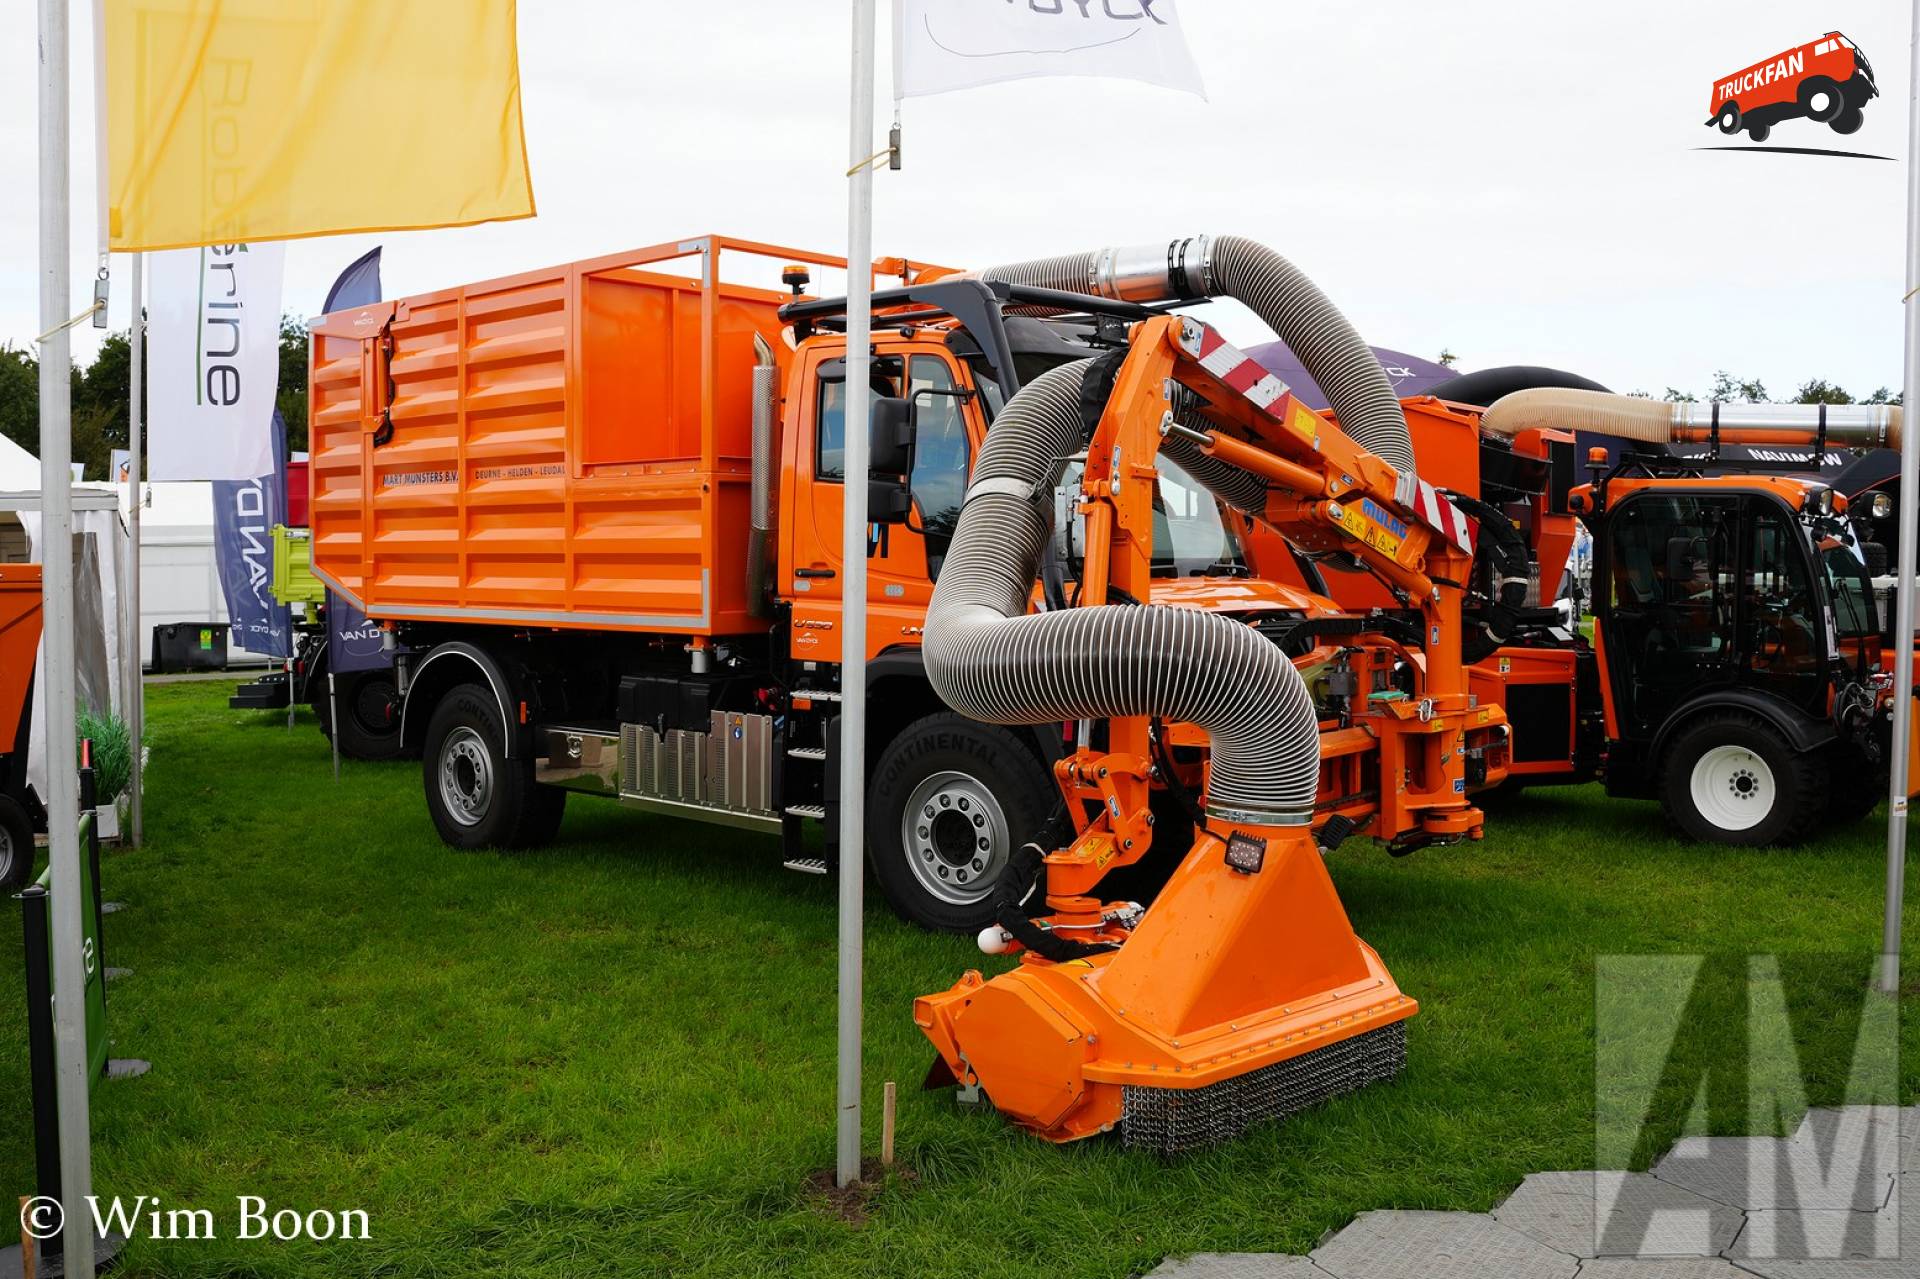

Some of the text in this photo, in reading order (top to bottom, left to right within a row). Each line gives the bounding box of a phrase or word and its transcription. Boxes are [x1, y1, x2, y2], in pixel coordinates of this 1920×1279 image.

[1382, 367, 1416, 377] CK
[383, 473, 402, 485] MART
[404, 471, 443, 484] MUNSTERS
[475, 469, 501, 479] DEURNE
[508, 467, 533, 477] HELDEN
[339, 629, 367, 641] VAN
[879, 733, 999, 797] CONTINENTAL
